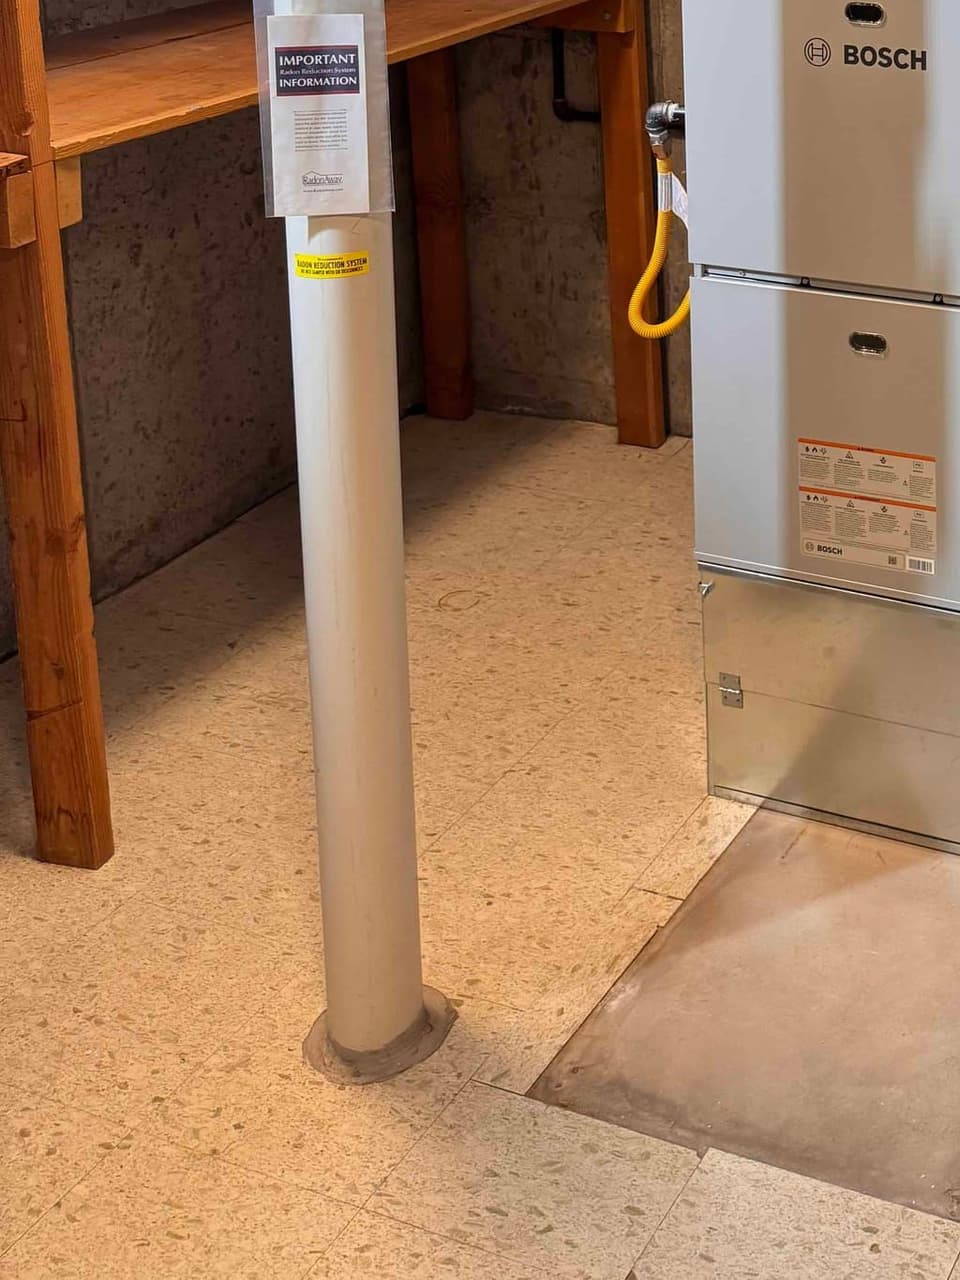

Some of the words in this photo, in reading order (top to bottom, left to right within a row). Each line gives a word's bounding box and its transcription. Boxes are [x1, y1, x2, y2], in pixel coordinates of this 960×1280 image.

[280, 54, 356, 66] IMPORTANT
[843, 44, 927, 71] BOSCH
[301, 67, 333, 75] Reduction
[333, 67, 356, 75] System
[280, 76, 357, 87] INFORMATION
[302, 175, 344, 186] RadonAway
[314, 260, 345, 269] REDUCTION
[346, 257, 368, 268] SYSTEM
[817, 544, 842, 555] BOSCH
